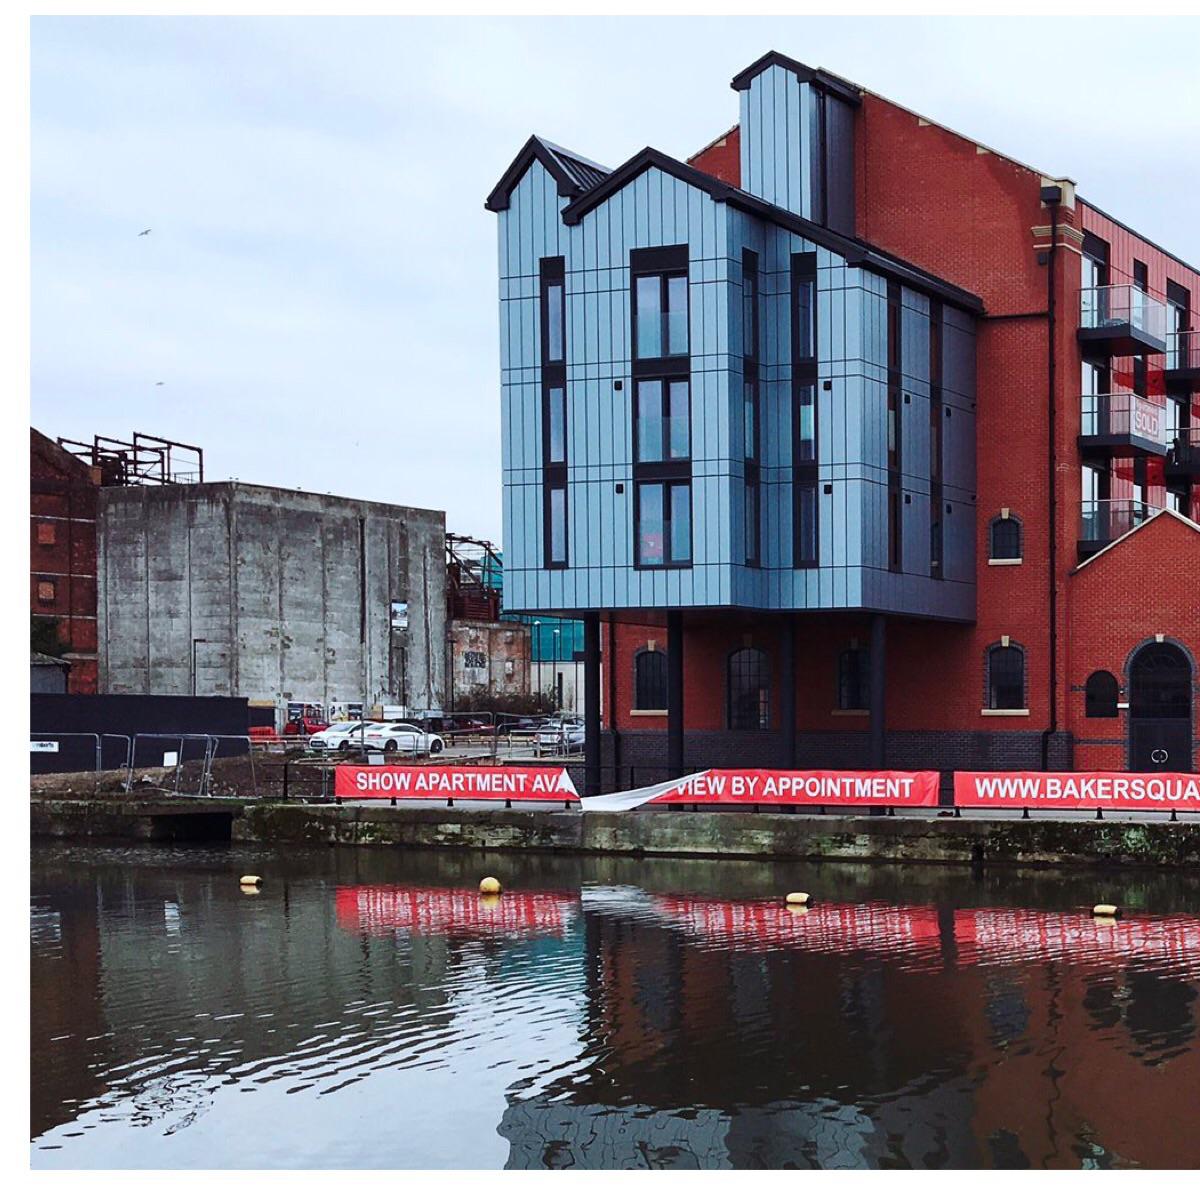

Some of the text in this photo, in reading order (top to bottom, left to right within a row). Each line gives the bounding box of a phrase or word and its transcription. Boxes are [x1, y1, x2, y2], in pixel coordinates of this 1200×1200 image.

[1135, 411, 1158, 434] SOLD
[356, 772, 411, 791] SHOW
[415, 772, 528, 792] APARTMENT
[732, 776, 758, 796] BY
[763, 777, 914, 798] APPOINTMENT
